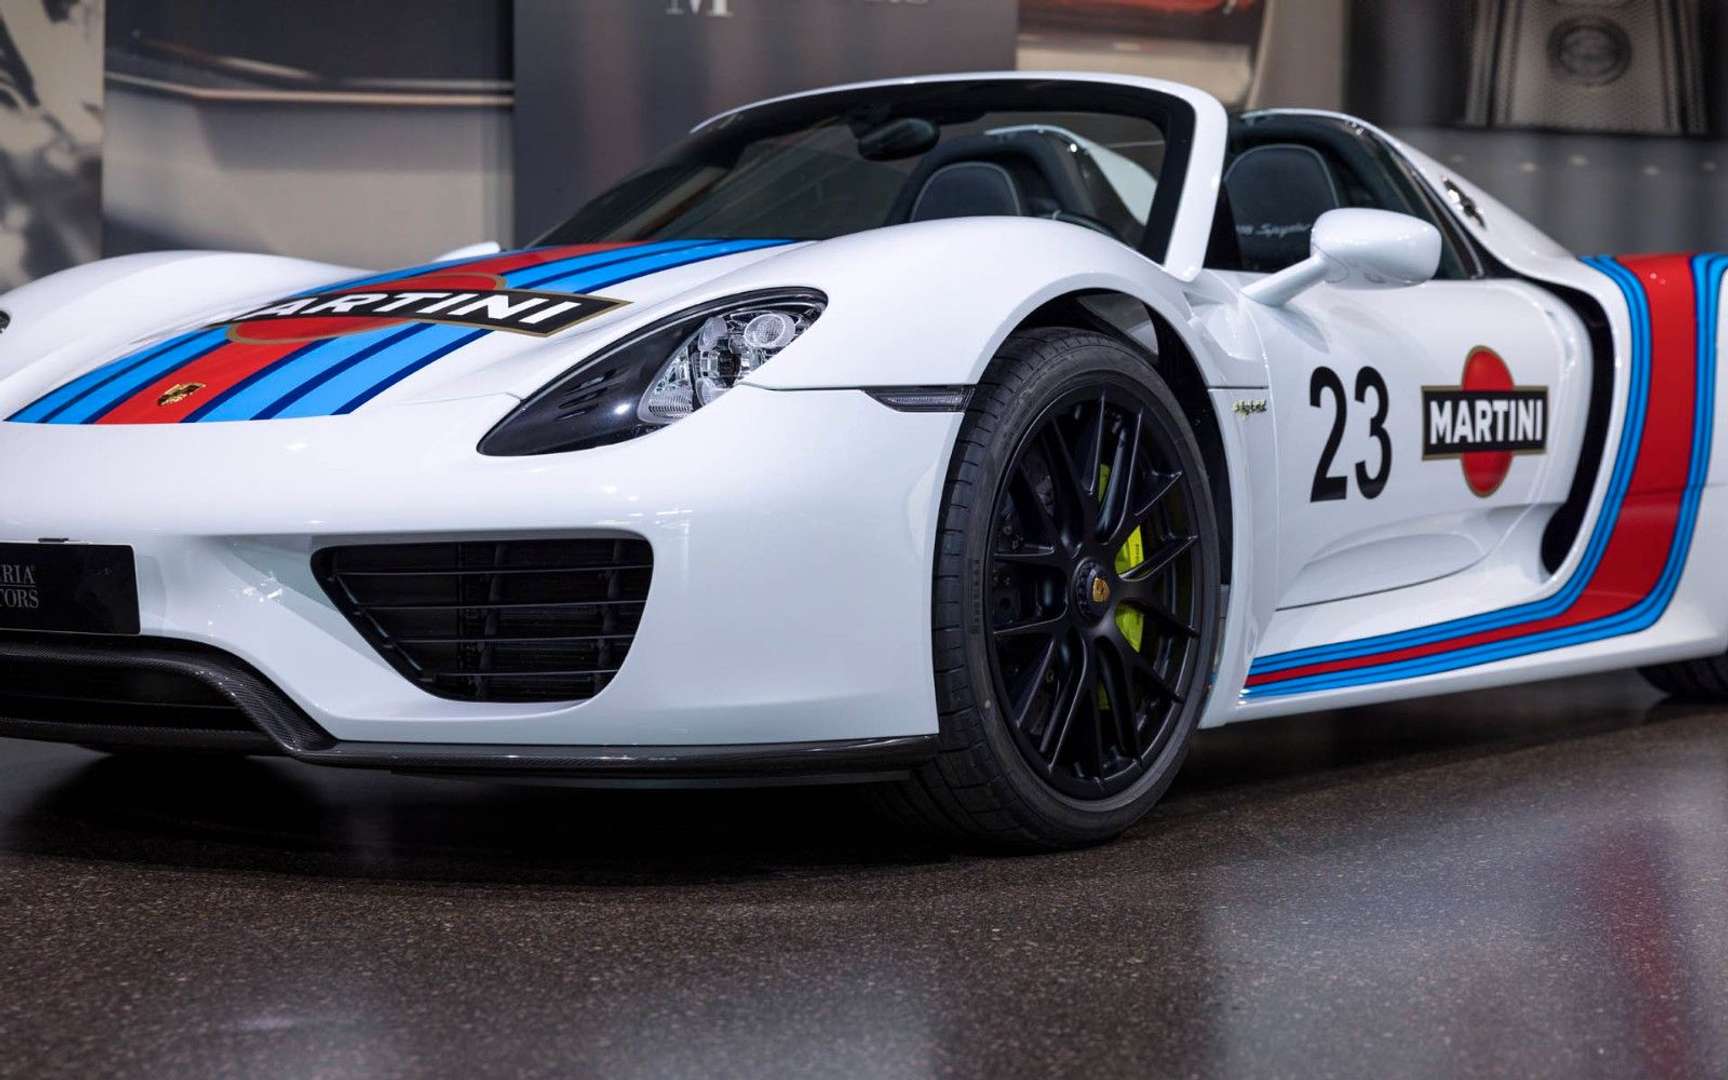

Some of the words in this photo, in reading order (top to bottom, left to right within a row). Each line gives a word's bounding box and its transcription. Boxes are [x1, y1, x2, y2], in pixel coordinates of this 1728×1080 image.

[231, 292, 582, 325] ARTINI
[1310, 366, 1392, 502] 23
[1430, 399, 1543, 445] MARTINI
[0, 564, 36, 584] RIA
